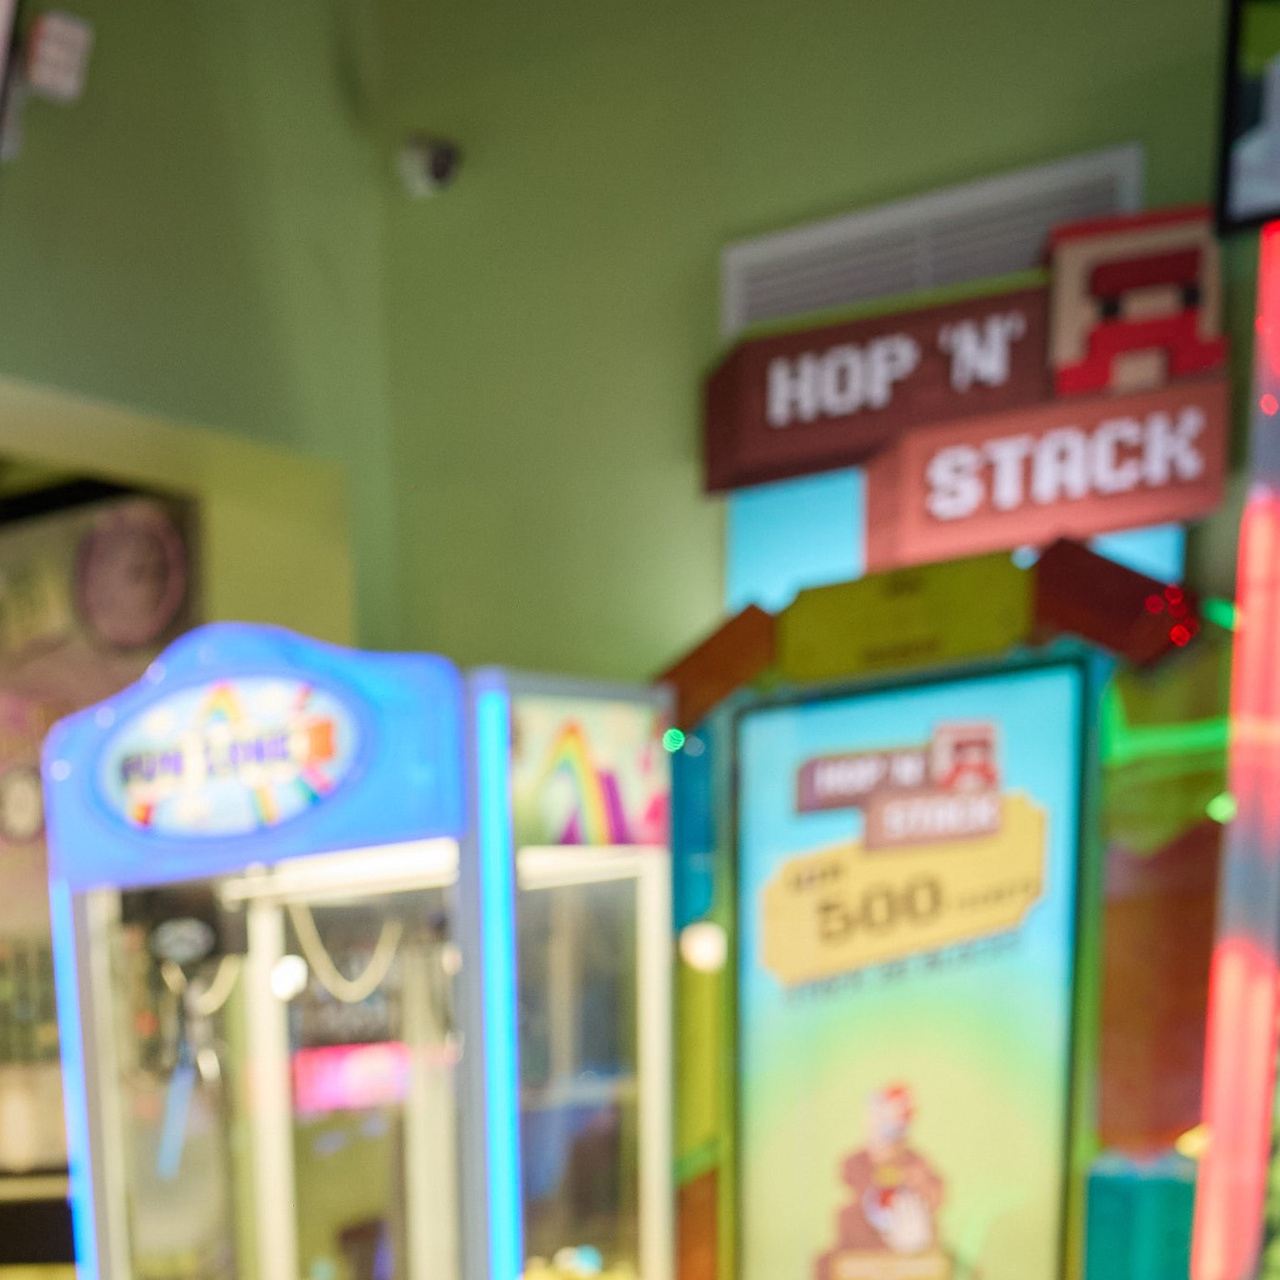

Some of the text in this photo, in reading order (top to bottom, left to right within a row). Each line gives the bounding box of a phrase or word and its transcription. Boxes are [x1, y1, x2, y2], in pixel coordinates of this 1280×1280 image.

[767, 336, 919, 427] HOP
[926, 407, 1204, 521] STACK
[817, 874, 942, 946] 500
